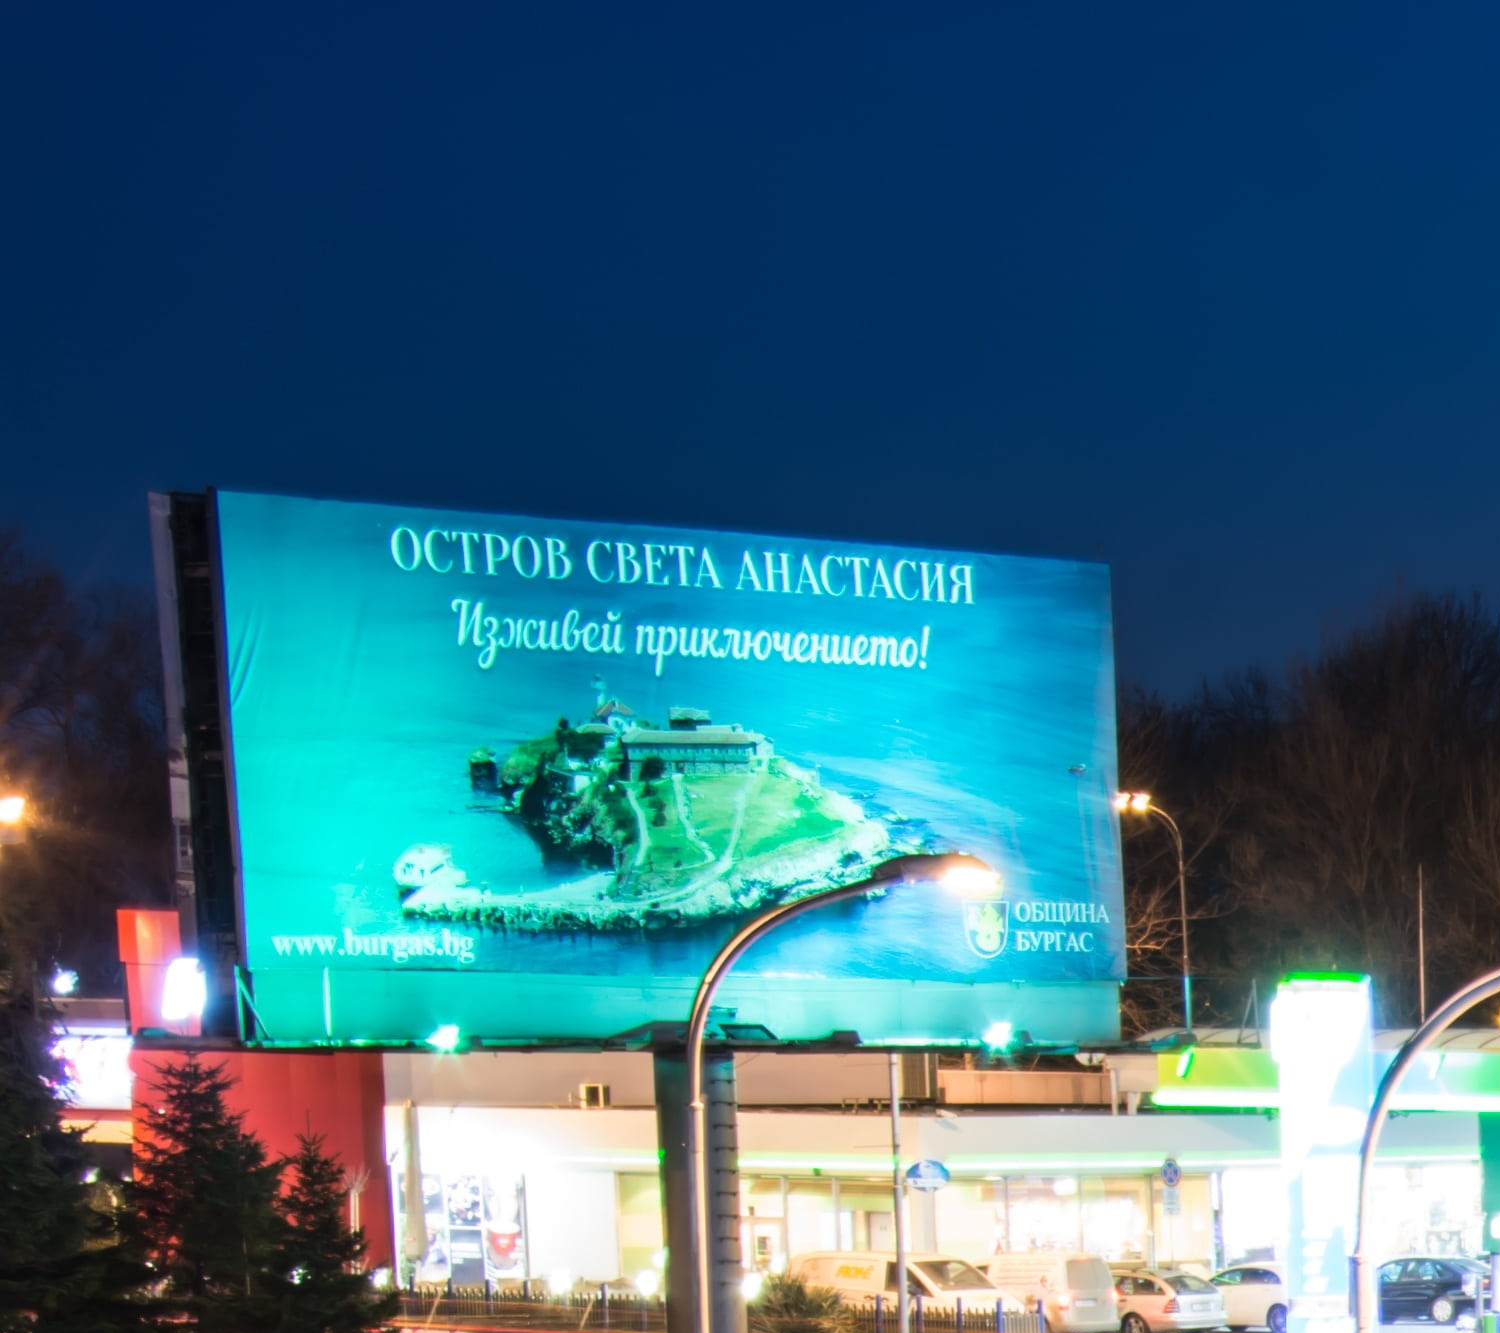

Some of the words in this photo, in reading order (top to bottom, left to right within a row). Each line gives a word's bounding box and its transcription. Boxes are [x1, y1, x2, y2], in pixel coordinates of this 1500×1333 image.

[391, 527, 573, 580] ОСТРОВ
[586, 541, 724, 589] СВЕТА
[736, 550, 976, 605] АНАСТАСИЯ
[451, 598, 624, 669] Изживей
[635, 624, 930, 677] приключението!
[1015, 902, 1110, 925] ОБЩИНА
[271, 927, 475, 963] www.burgas.bg
[1016, 931, 1094, 952] БУРГАС
